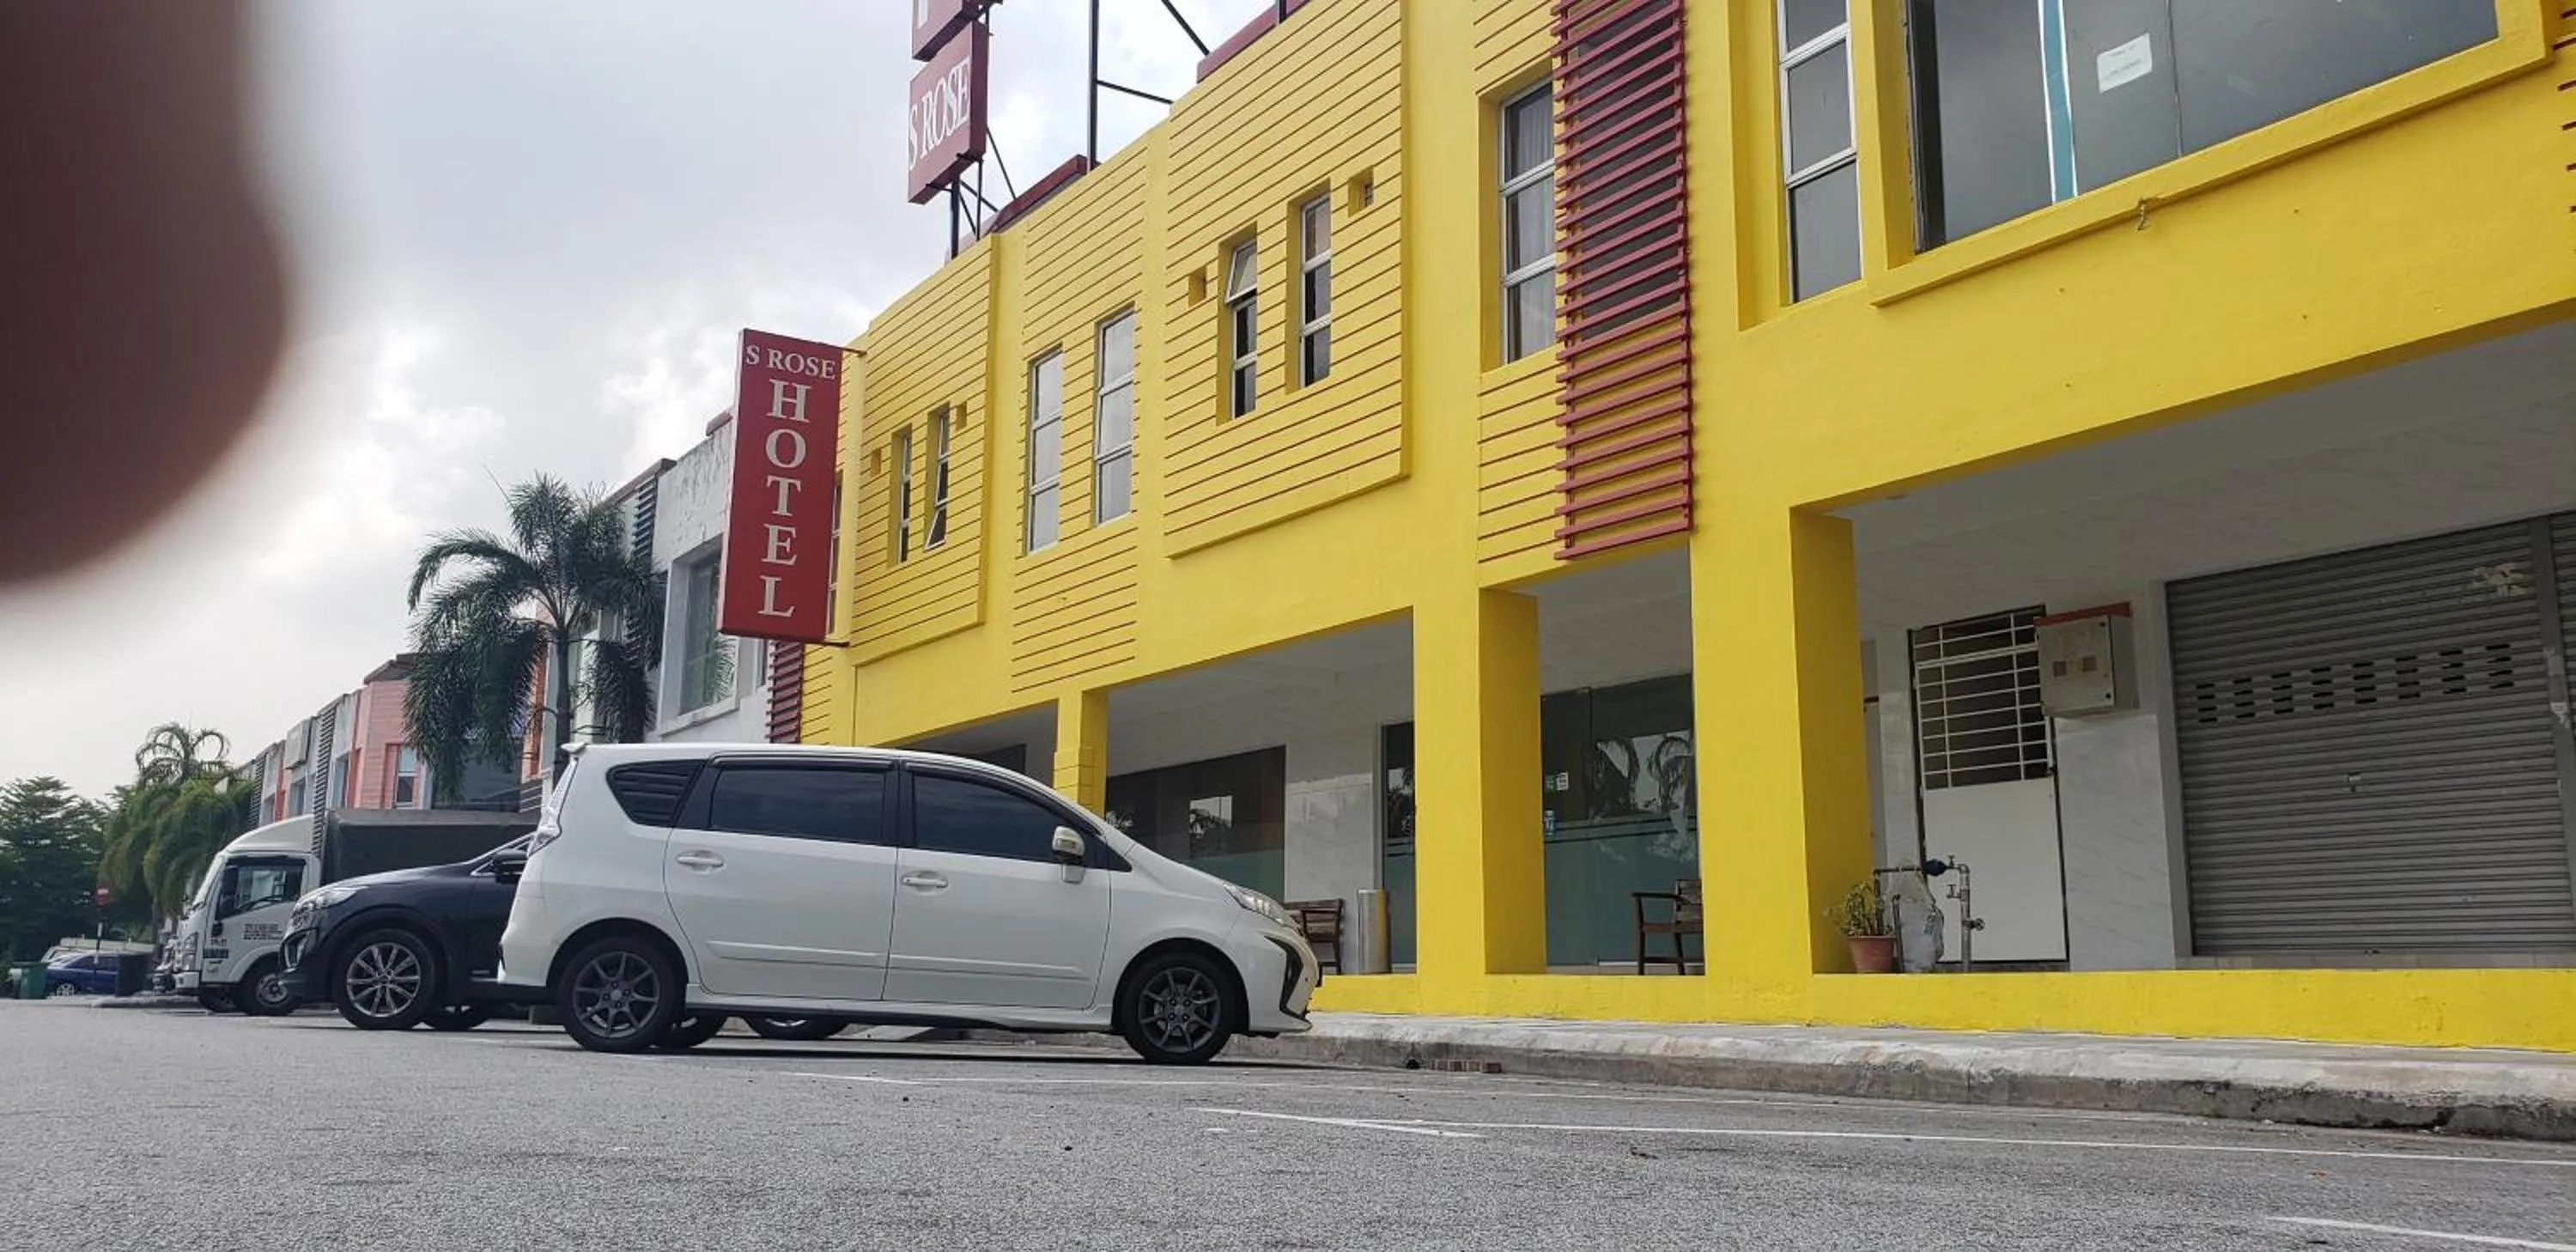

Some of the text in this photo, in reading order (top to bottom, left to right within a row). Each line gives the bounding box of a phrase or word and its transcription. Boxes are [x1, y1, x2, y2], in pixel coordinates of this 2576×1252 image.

[908, 56, 970, 171] S ROSE
[746, 343, 835, 380] S ROSE
[757, 378, 812, 619] HOTEL
